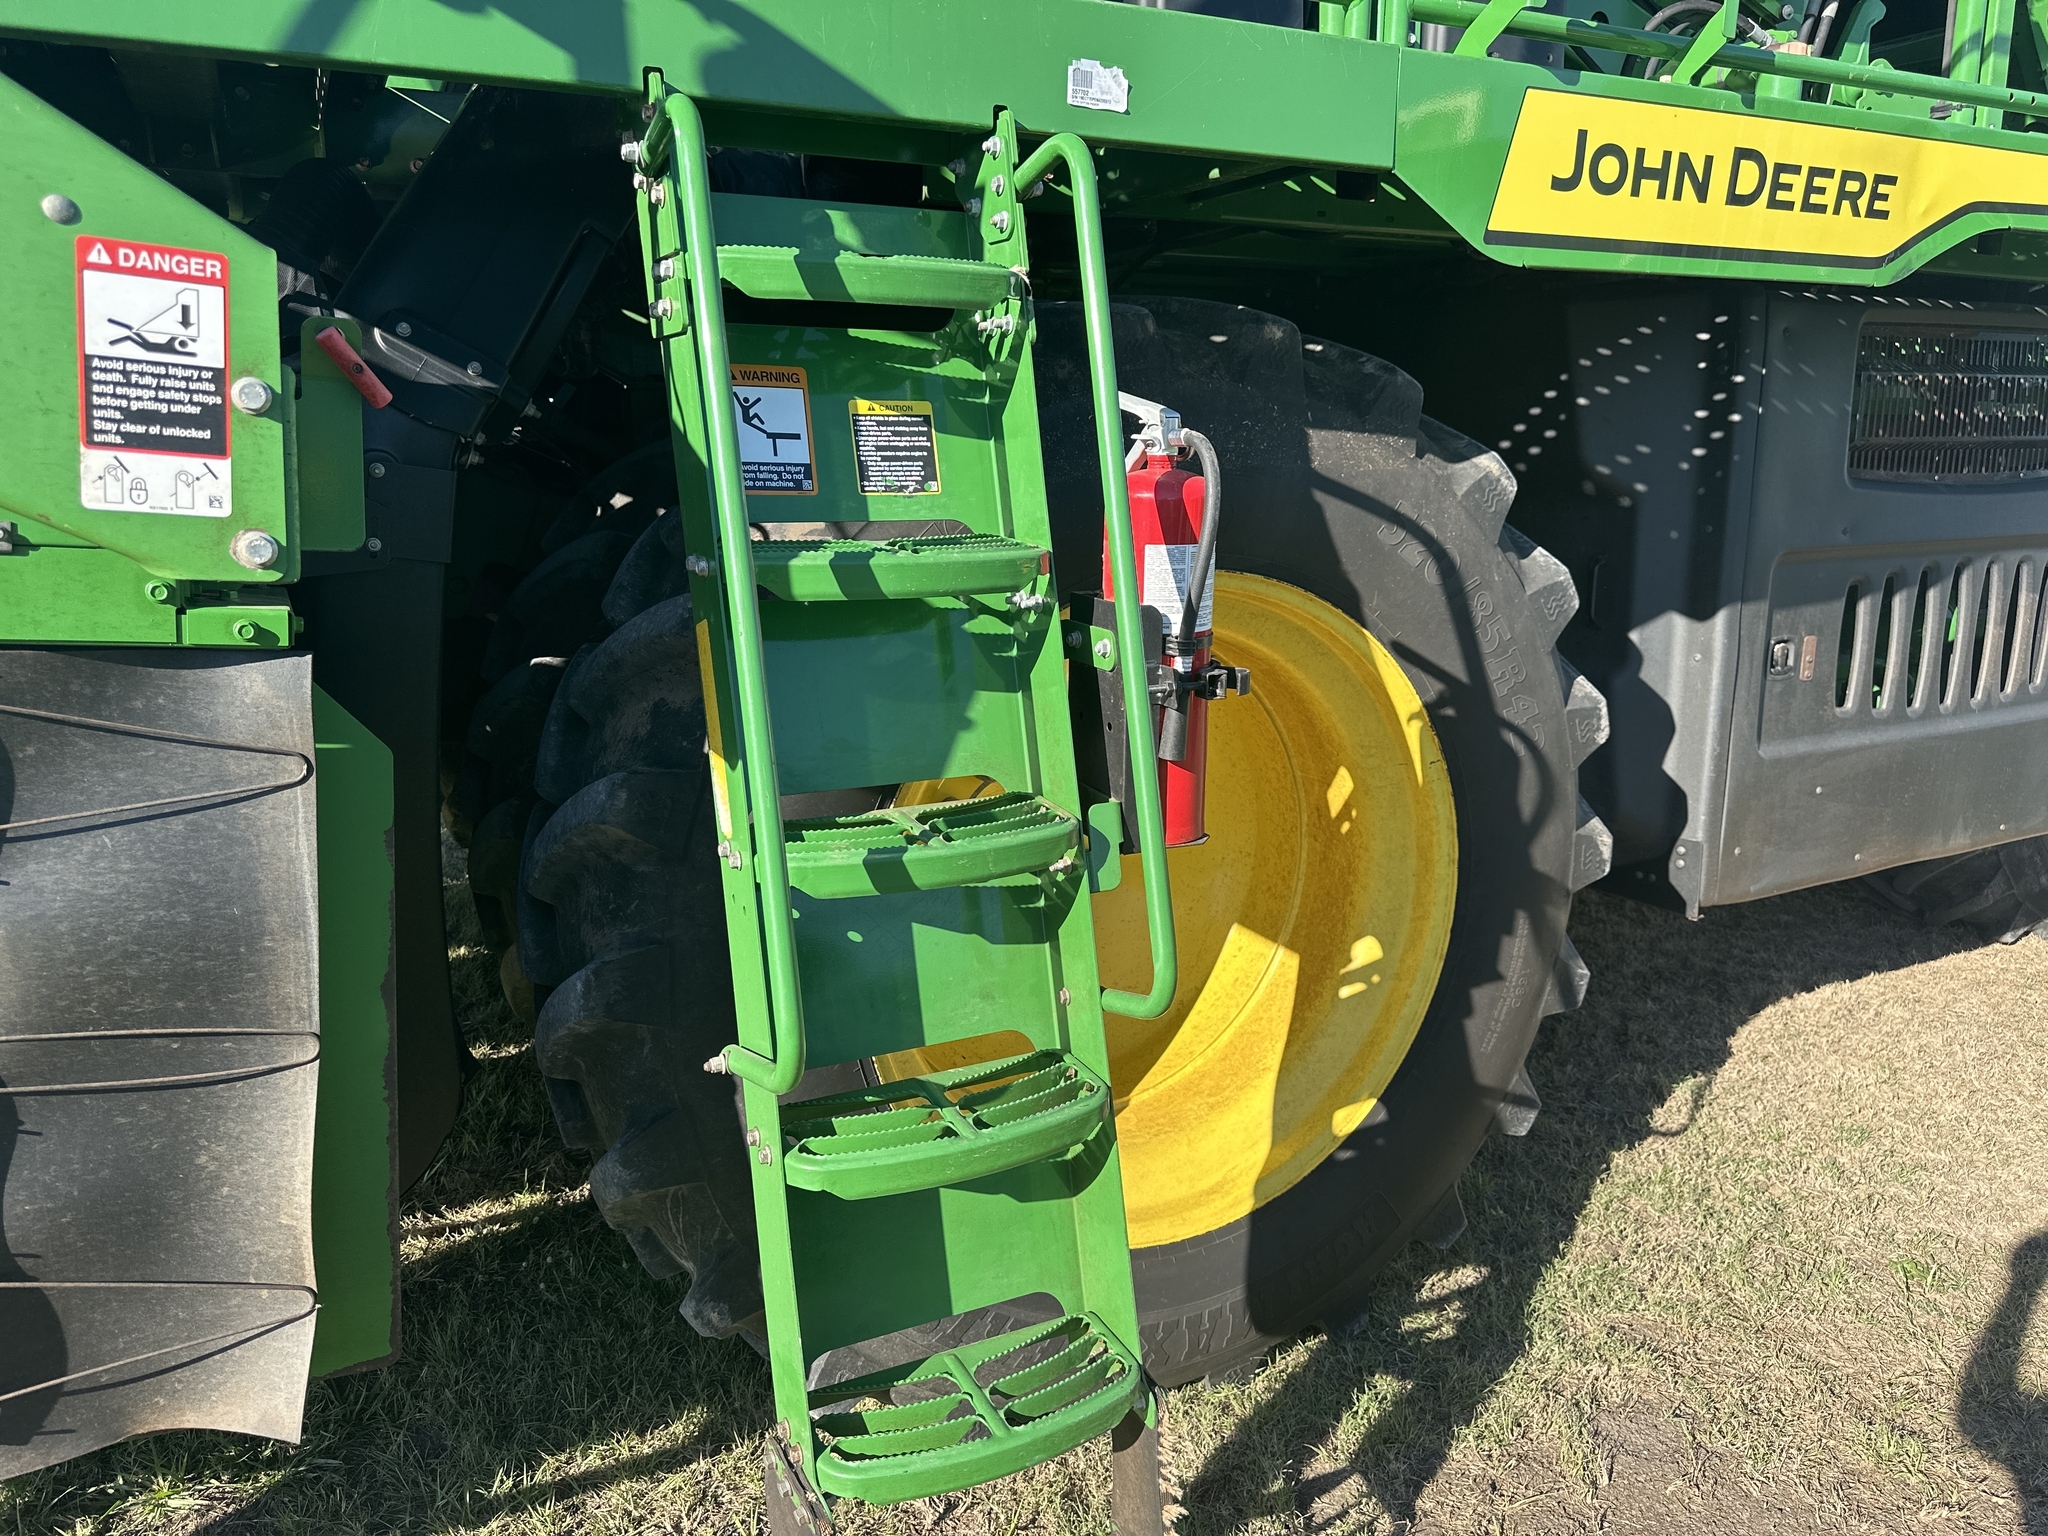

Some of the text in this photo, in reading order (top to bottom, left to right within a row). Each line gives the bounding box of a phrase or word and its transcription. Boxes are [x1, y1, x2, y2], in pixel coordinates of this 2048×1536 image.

[1550, 128, 1898, 221] JOHN DEERE
[118, 247, 221, 279] DANGER
[92, 358, 213, 379] Avoid serious injury or
[739, 370, 800, 383] WARNING
[92, 371, 215, 391] death. Fully raise units
[93, 384, 222, 405] and engage safety stops
[93, 395, 202, 414] before getting under
[93, 409, 124, 419] units.
[93, 420, 211, 439] Stay clear of unlocked
[94, 433, 125, 444] units.
